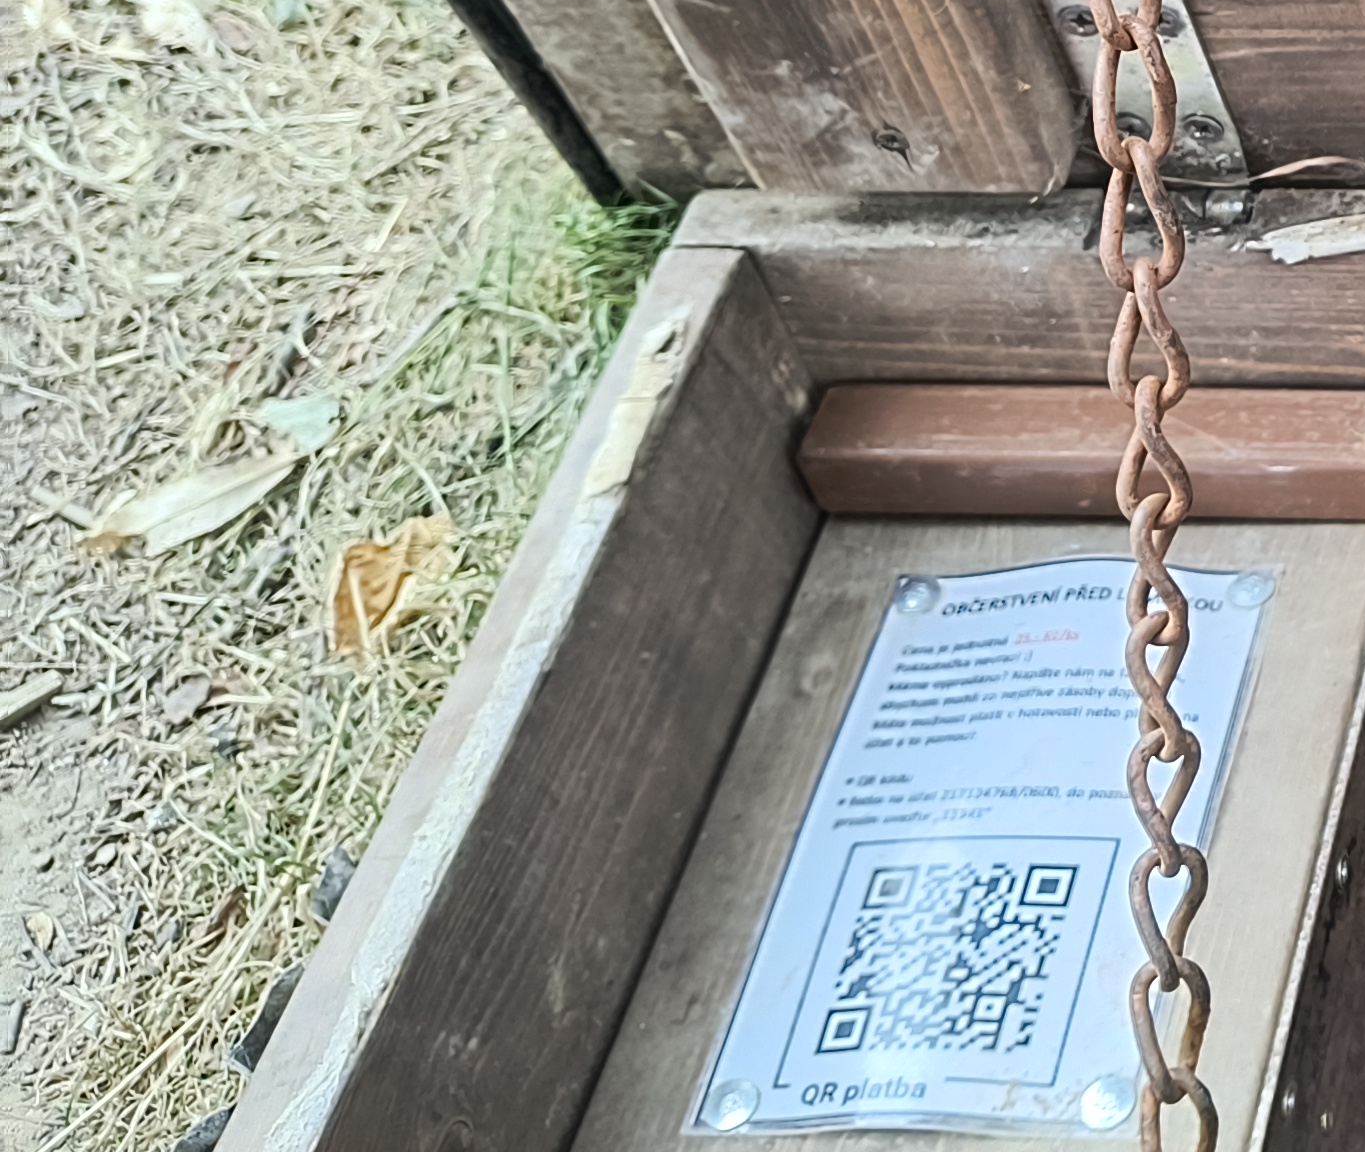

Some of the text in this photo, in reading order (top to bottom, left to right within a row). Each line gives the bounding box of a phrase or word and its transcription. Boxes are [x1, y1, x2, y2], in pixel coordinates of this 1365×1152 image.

[941, 585, 1063, 617] OBČERSTVENÍ
[1064, 584, 1113, 603] PŘED
[1064, 666, 1095, 679] nám
[1099, 669, 1116, 679] na
[1018, 707, 1083, 719] hotovosti
[1085, 707, 1122, 719] nebo
[800, 1074, 928, 1107] QR platba
